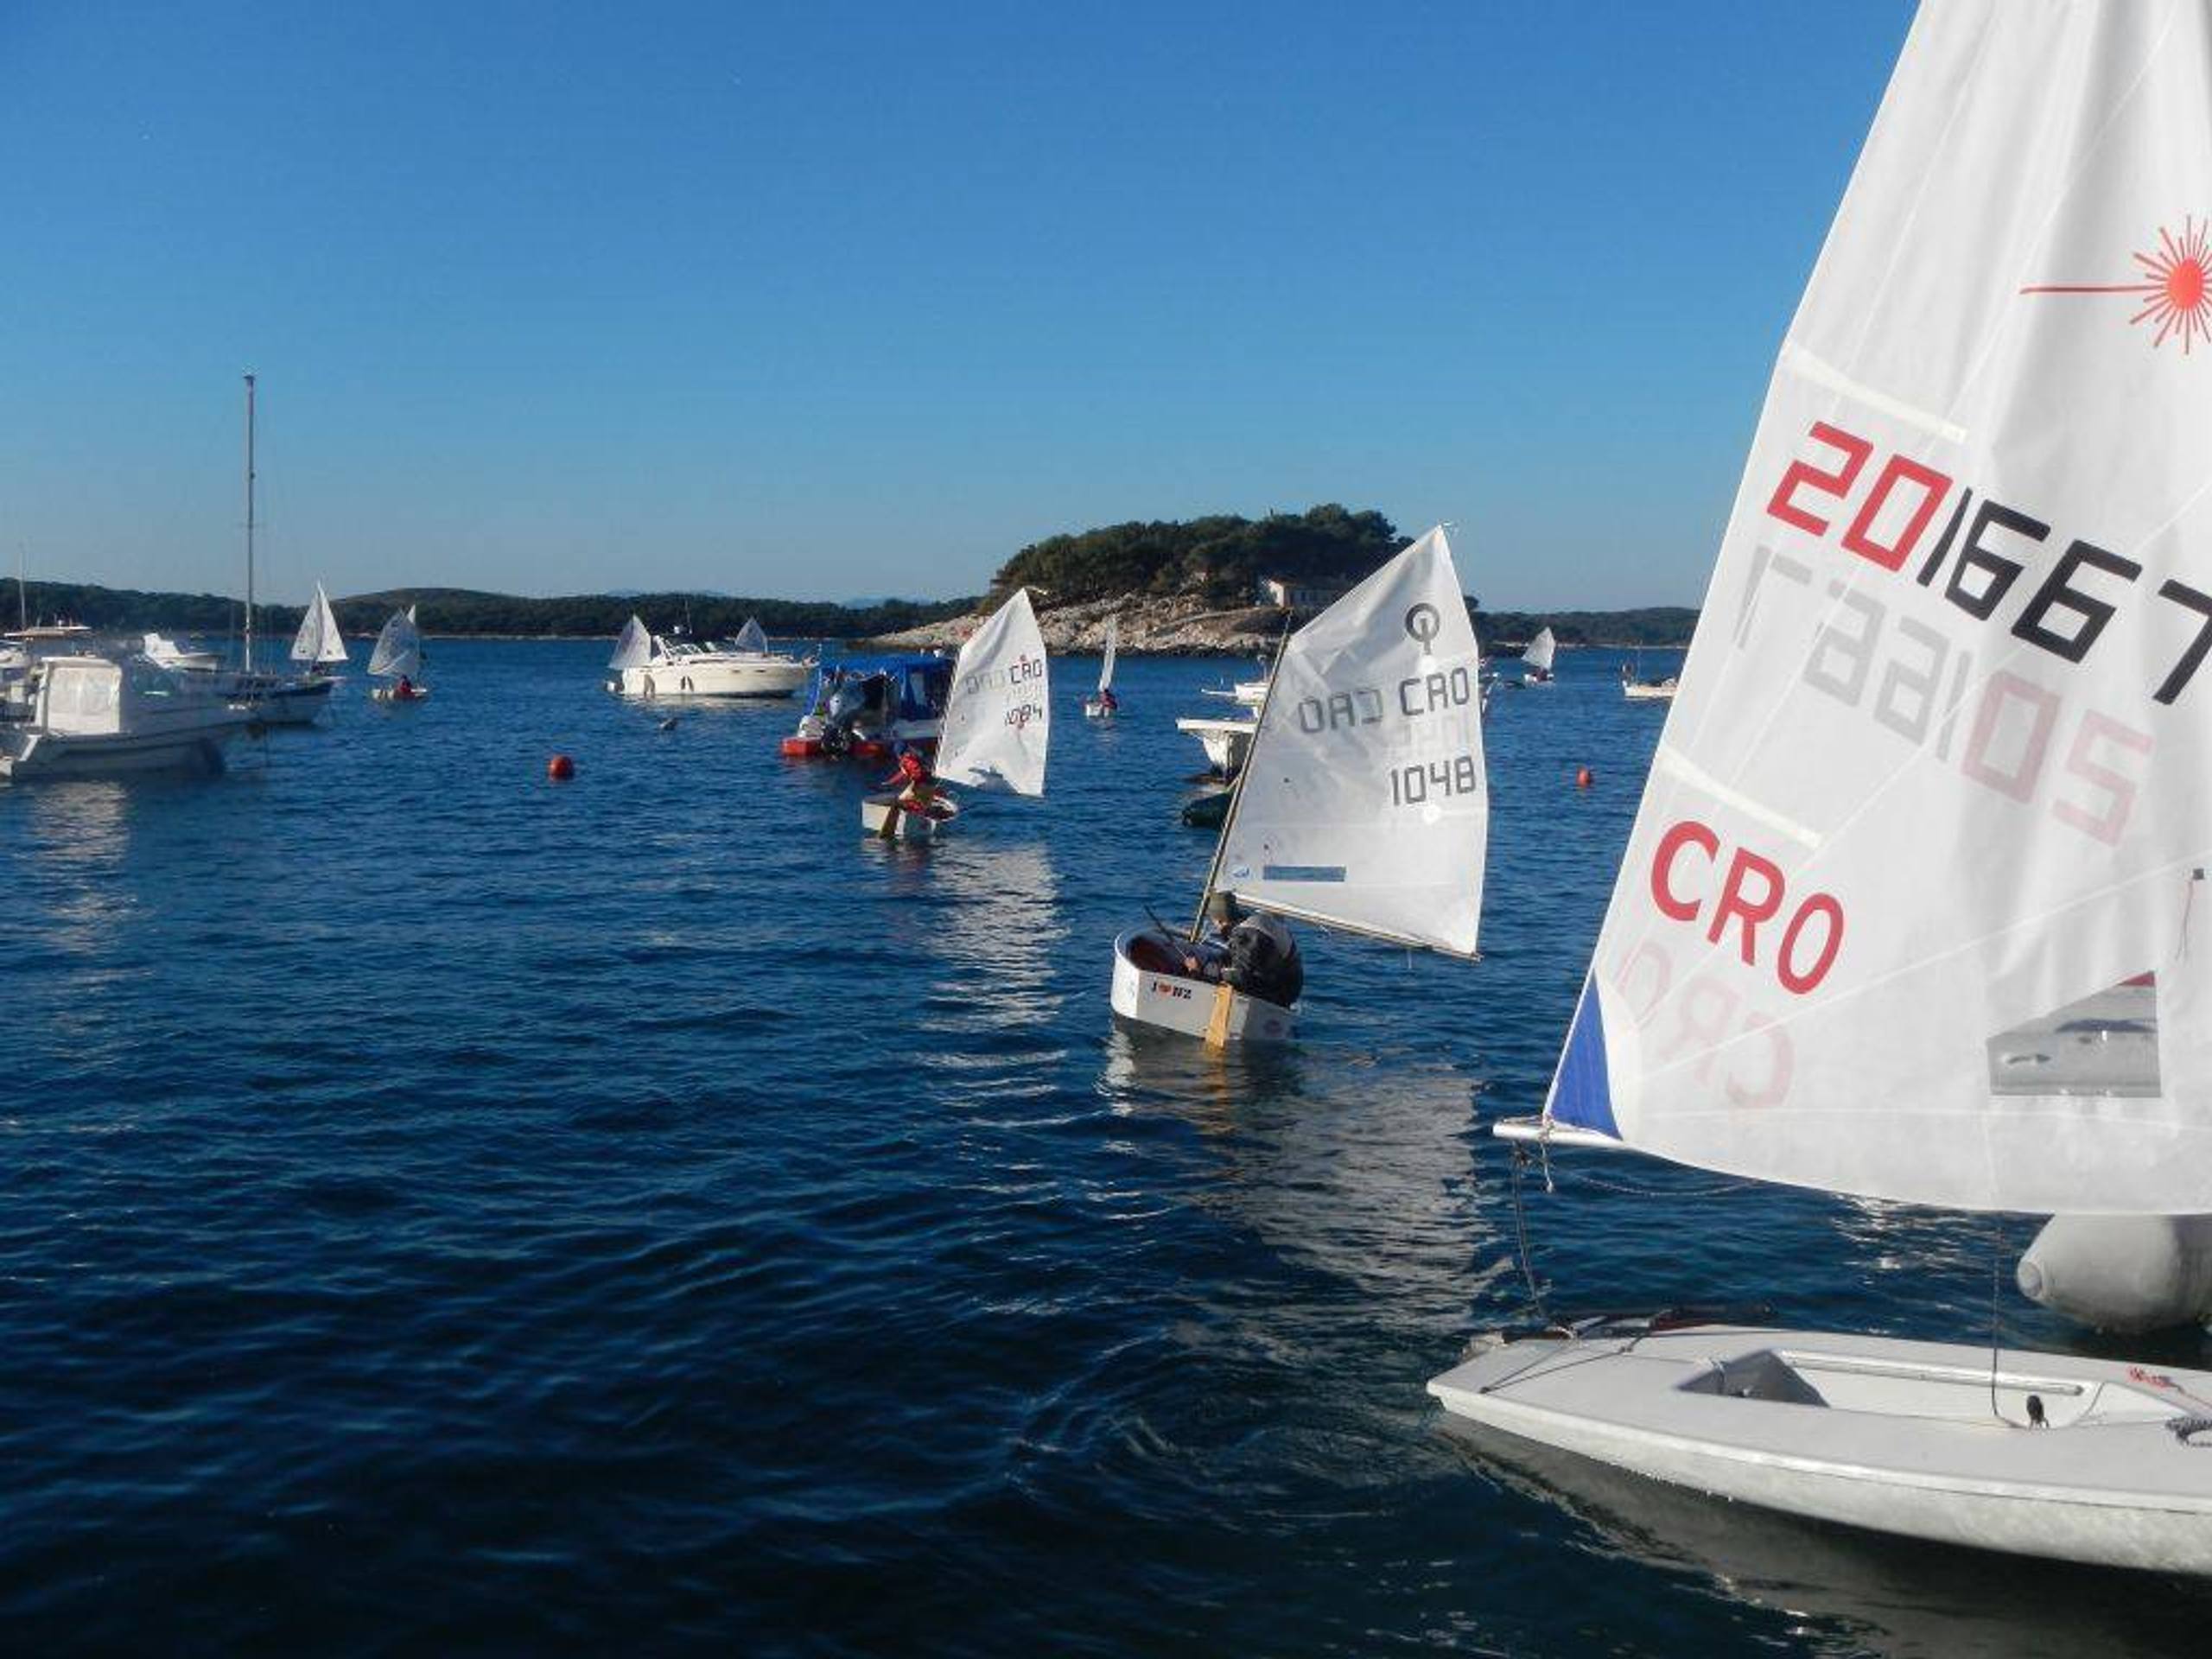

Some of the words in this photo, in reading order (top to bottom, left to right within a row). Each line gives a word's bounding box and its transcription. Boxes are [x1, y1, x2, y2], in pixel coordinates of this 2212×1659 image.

[1766, 421, 2212, 705] 201667
[1009, 658, 1042, 683] CRO
[1399, 667, 1470, 716] CRO
[1390, 755, 1476, 805] 1048
[1650, 820, 1844, 995] CRO
